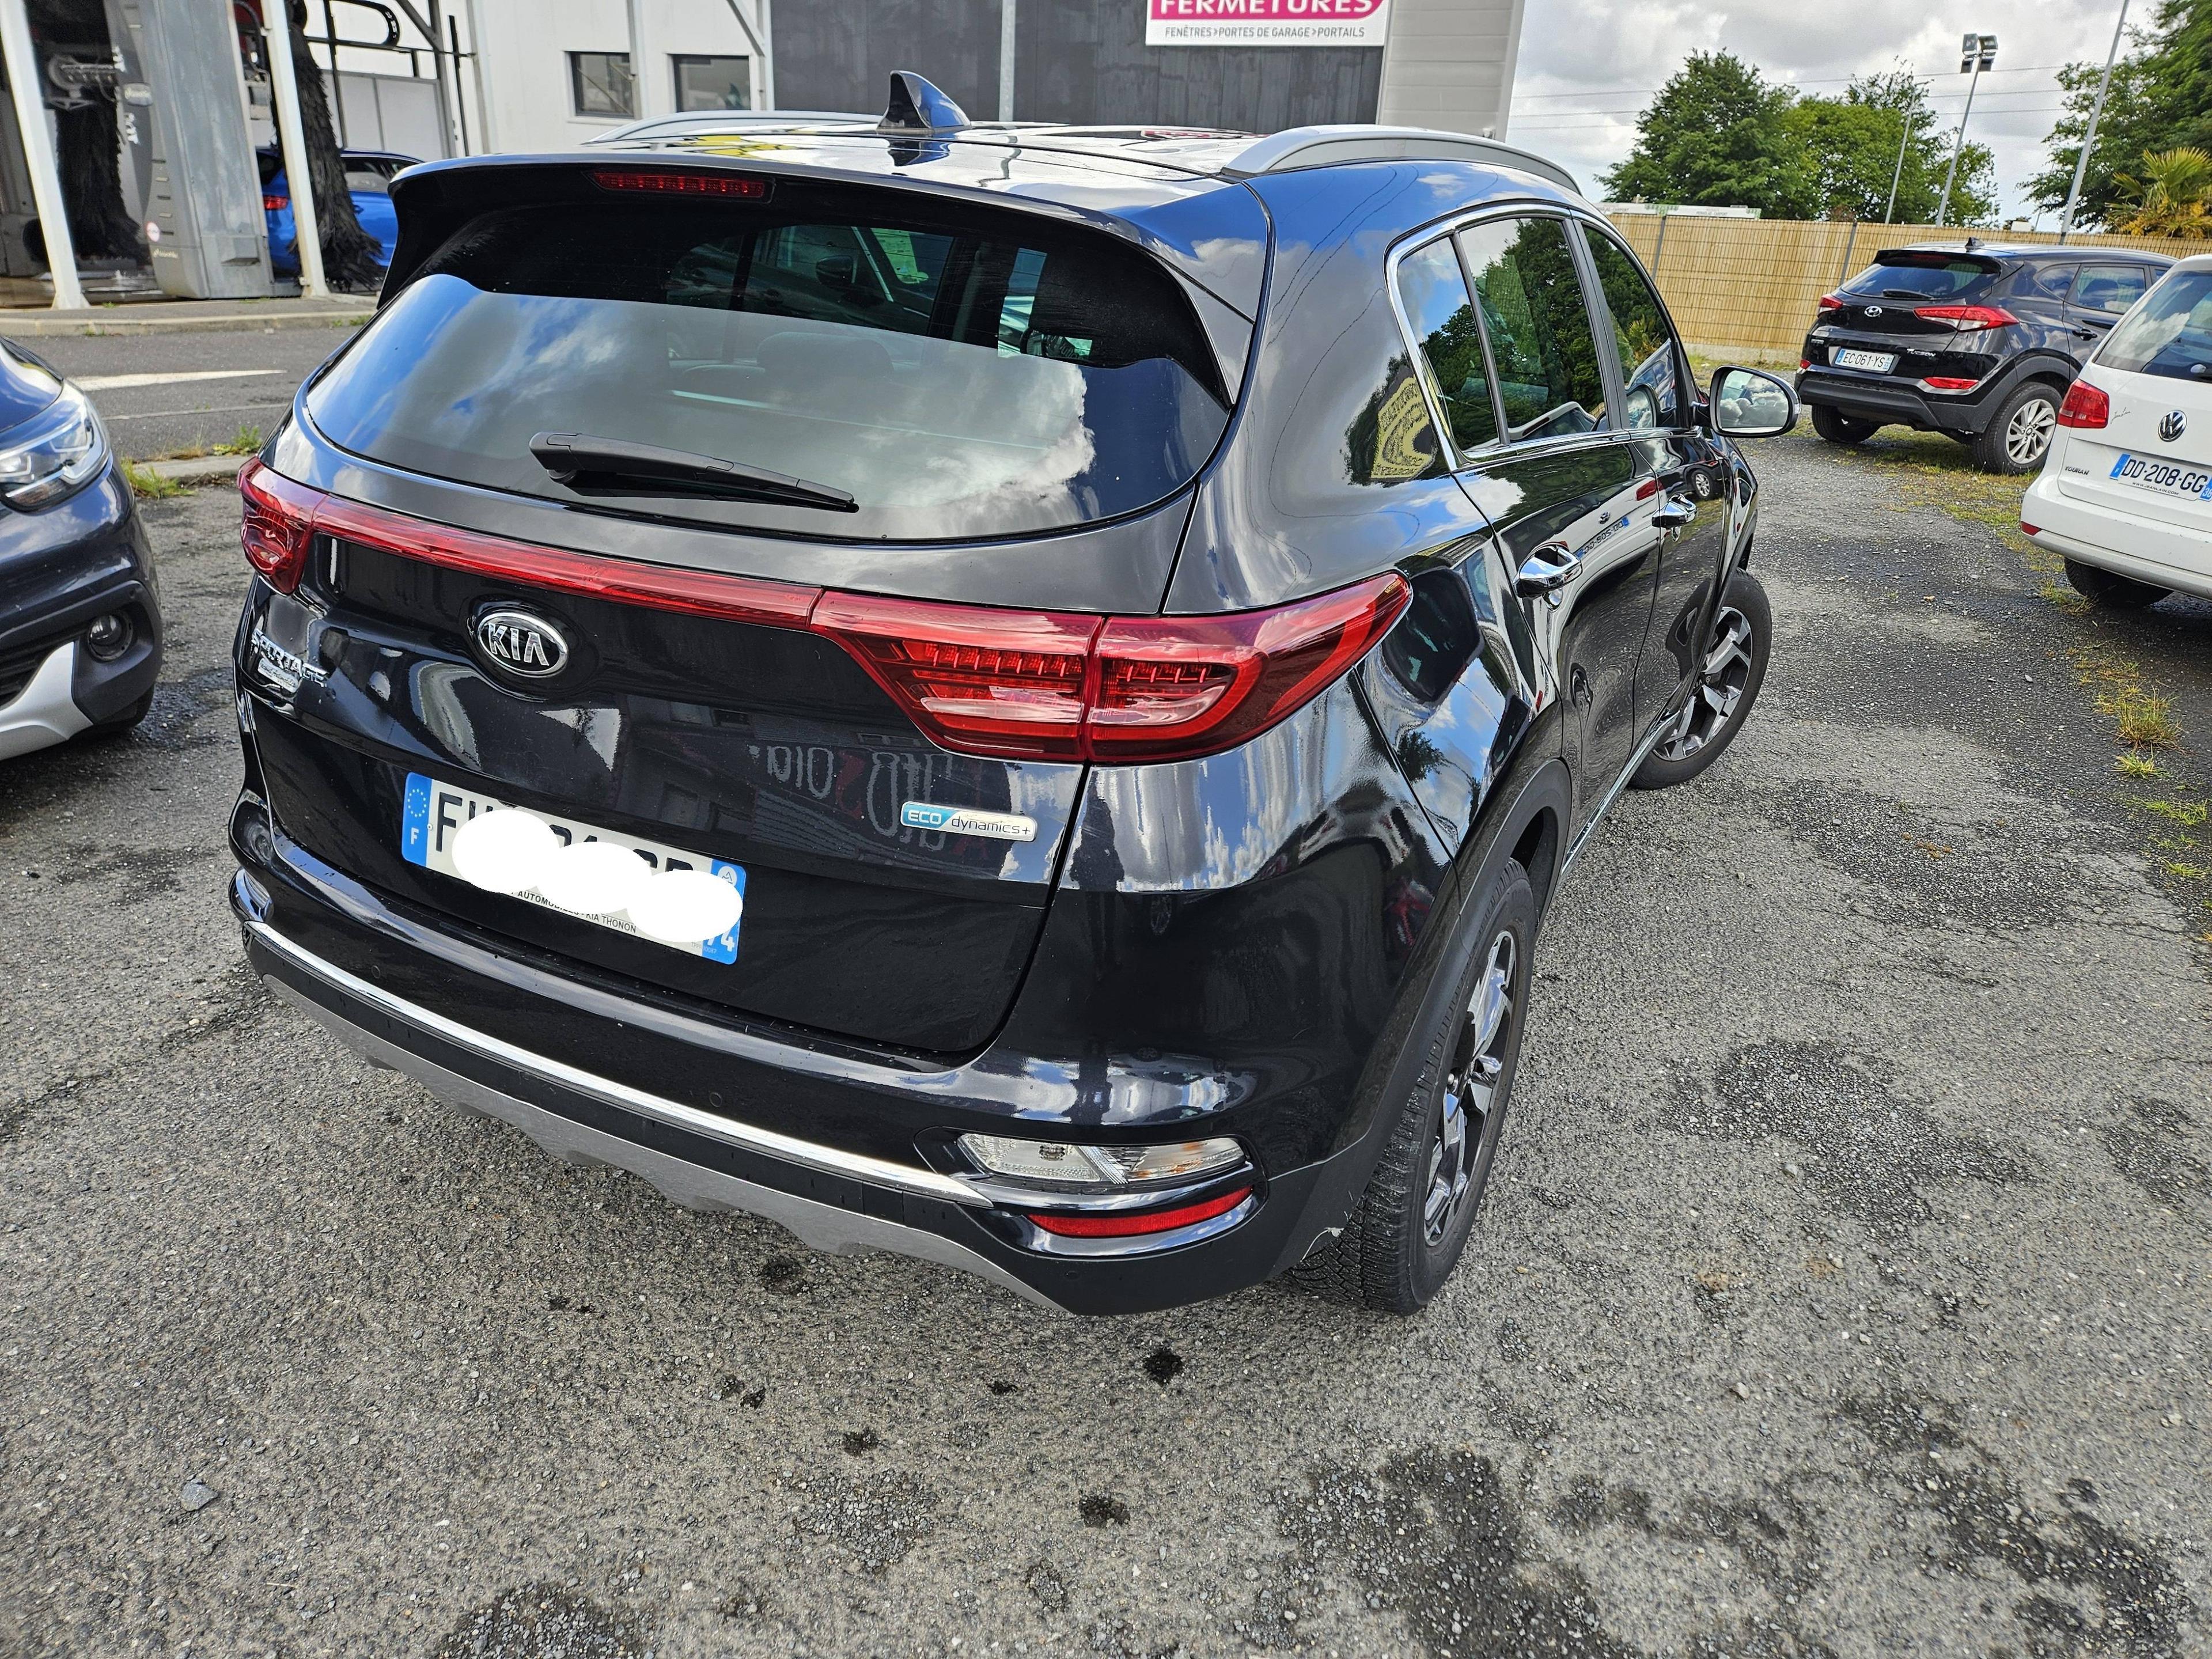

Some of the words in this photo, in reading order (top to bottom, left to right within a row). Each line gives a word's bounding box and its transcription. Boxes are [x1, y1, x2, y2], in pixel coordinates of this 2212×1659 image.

[1161, 0, 1373, 14] FERMETURES
[1219, 26, 1254, 37] PORTES
[1257, 27, 1270, 37] DE
[1271, 27, 1310, 37] GARAGE
[1317, 26, 1365, 37] PORTAILS
[2065, 466, 2090, 475] TOURAN
[488, 622, 550, 666] KIA
[251, 628, 328, 687] SPORTAGE
[907, 810, 942, 825] ECO
[411, 827, 419, 845] F
[601, 915, 637, 933] THONON
